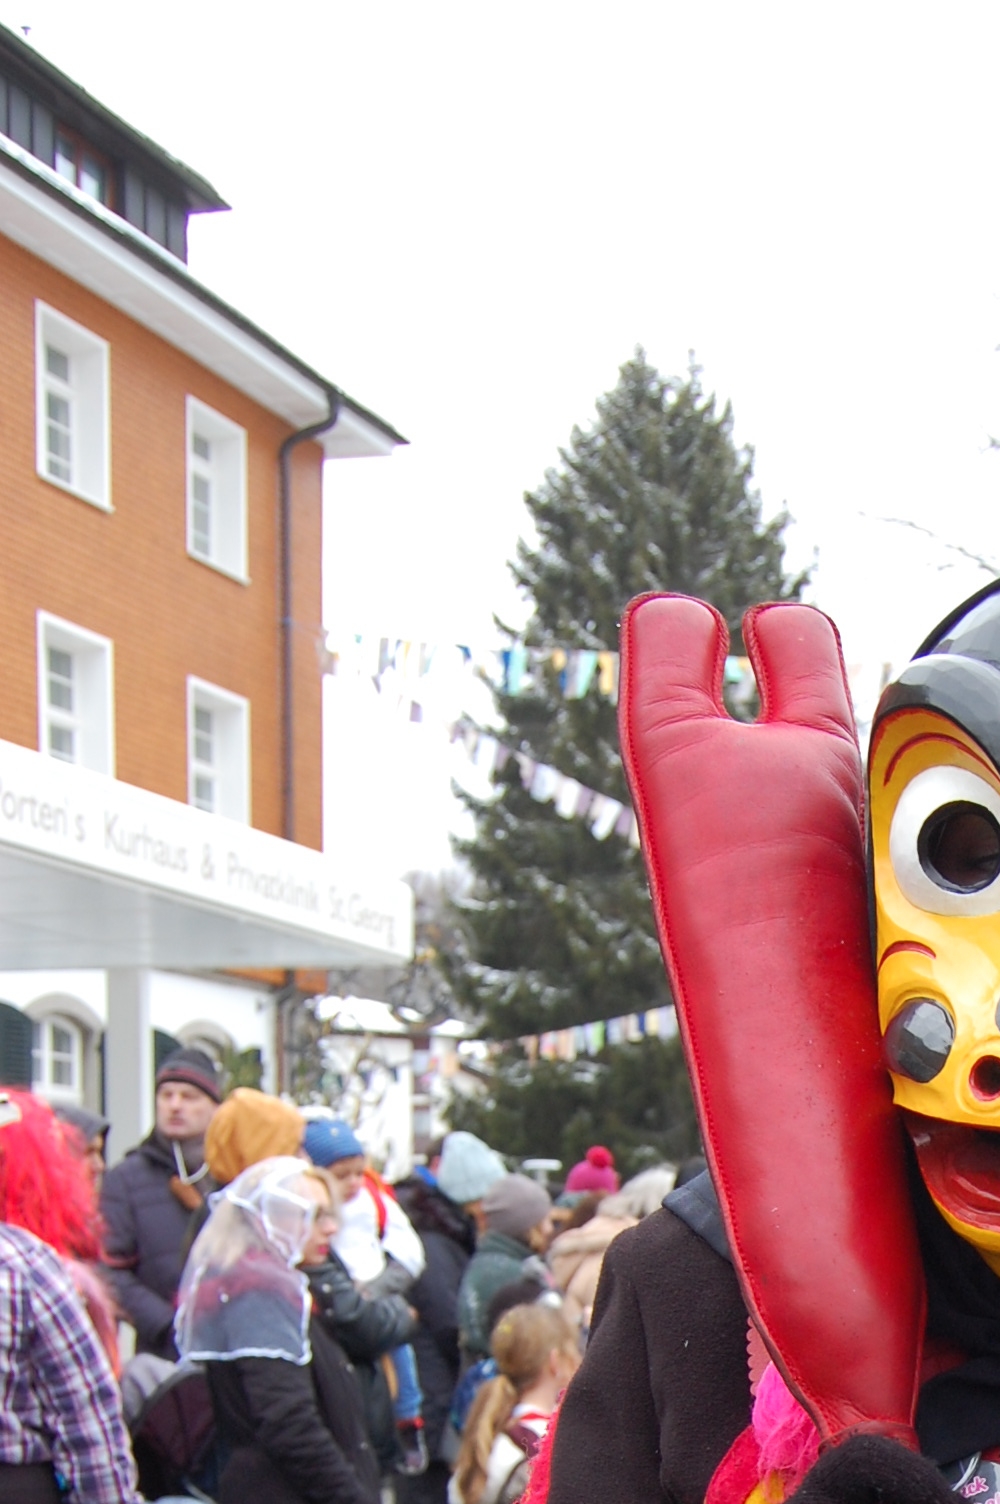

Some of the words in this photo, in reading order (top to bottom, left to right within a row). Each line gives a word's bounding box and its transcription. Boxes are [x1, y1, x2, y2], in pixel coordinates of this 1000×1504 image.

[0, 777, 86, 842] orten's
[104, 810, 189, 873] Kurhaus
[200, 841, 216, 882] &
